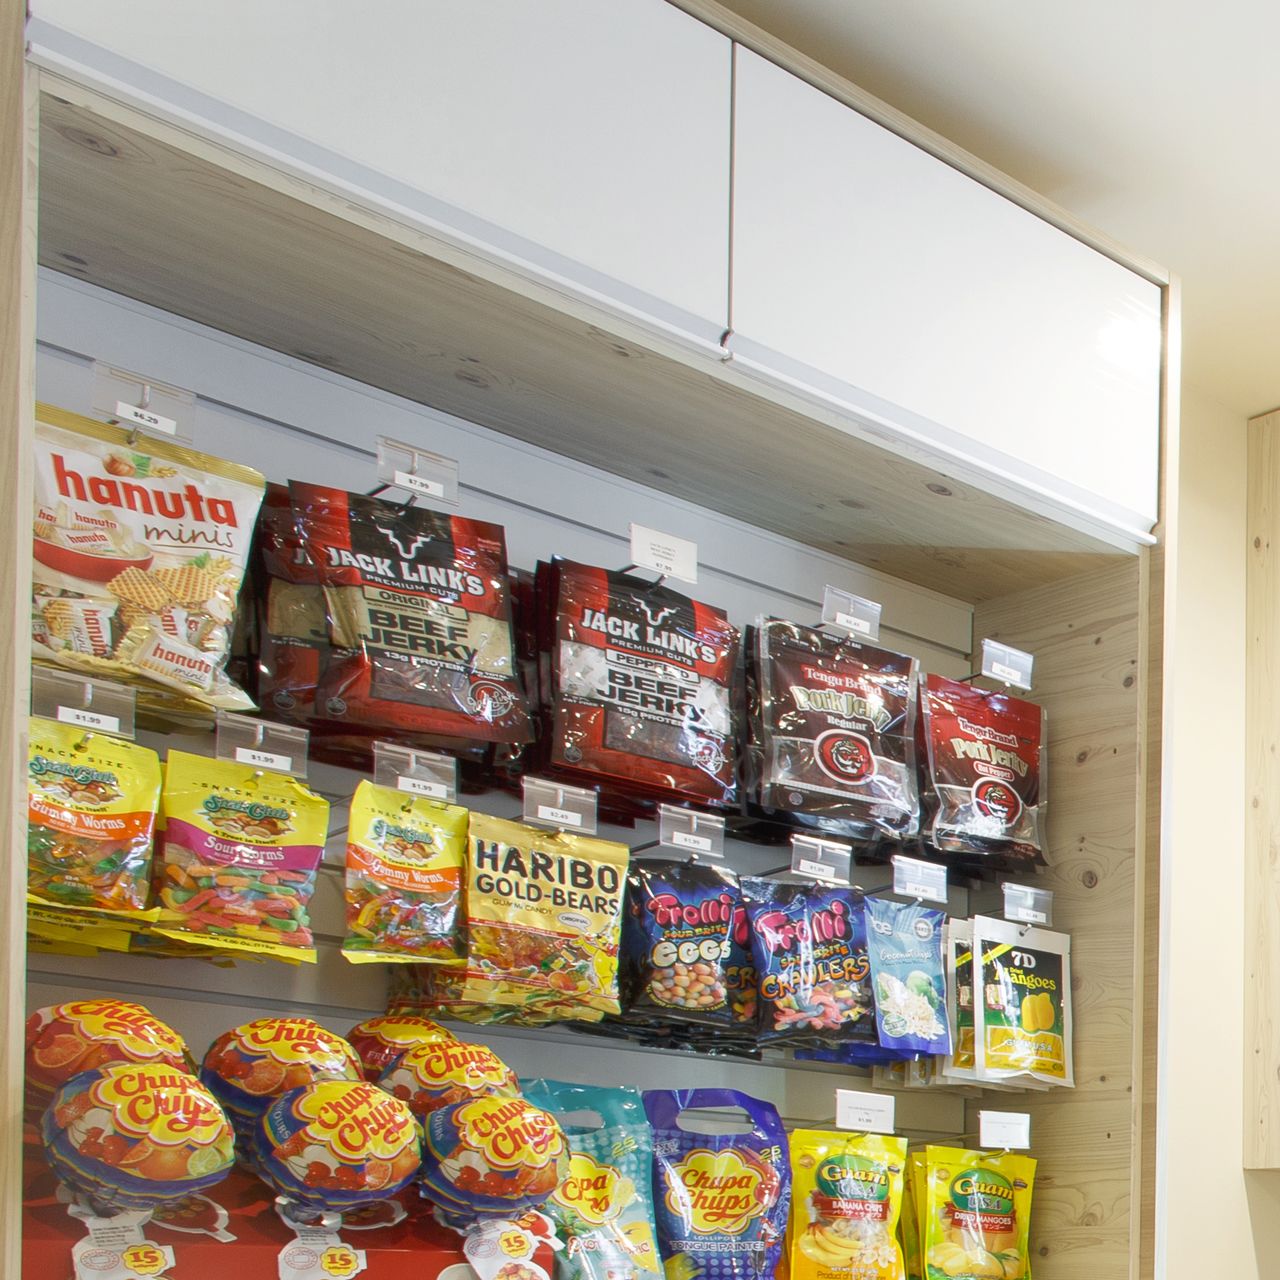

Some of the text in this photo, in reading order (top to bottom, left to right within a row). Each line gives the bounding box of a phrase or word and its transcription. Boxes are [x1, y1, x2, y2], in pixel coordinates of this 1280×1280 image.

[51, 453, 238, 528] hanuta
[144, 523, 233, 548] minis
[329, 547, 485, 595] JACK LINK'S
[380, 590, 455, 616] ORIGINAL
[369, 608, 468, 642] BEEF
[582, 608, 717, 664] JACK LINK'S
[152, 643, 212, 673] hanuta
[359, 625, 478, 664] JERKY
[611, 638, 693, 665] PREMIUM CUTS
[608, 669, 698, 698] BEEF
[804, 667, 881, 696] Tengu Brand
[74, 714, 100, 725] $1.99
[827, 715, 868, 730] Regular
[252, 754, 274, 764] $1.99
[412, 783, 432, 792] $1.99
[476, 838, 619, 894] HARIBO
[477, 873, 619, 917] GOLD-BEARS
[648, 893, 734, 927] Trolli
[754, 901, 851, 951] Trolli
[1011, 950, 1036, 968] 7D
[760, 955, 870, 999] CRAWLERS
[492, 1111, 556, 1160] Chups
[681, 1169, 752, 1191] Chupa
[820, 1164, 887, 1185] Guam
[954, 1178, 1013, 1200] Guam
[681, 1190, 752, 1222] Chups
[503, 1235, 524, 1248] 15
[327, 1254, 351, 1266] 15
